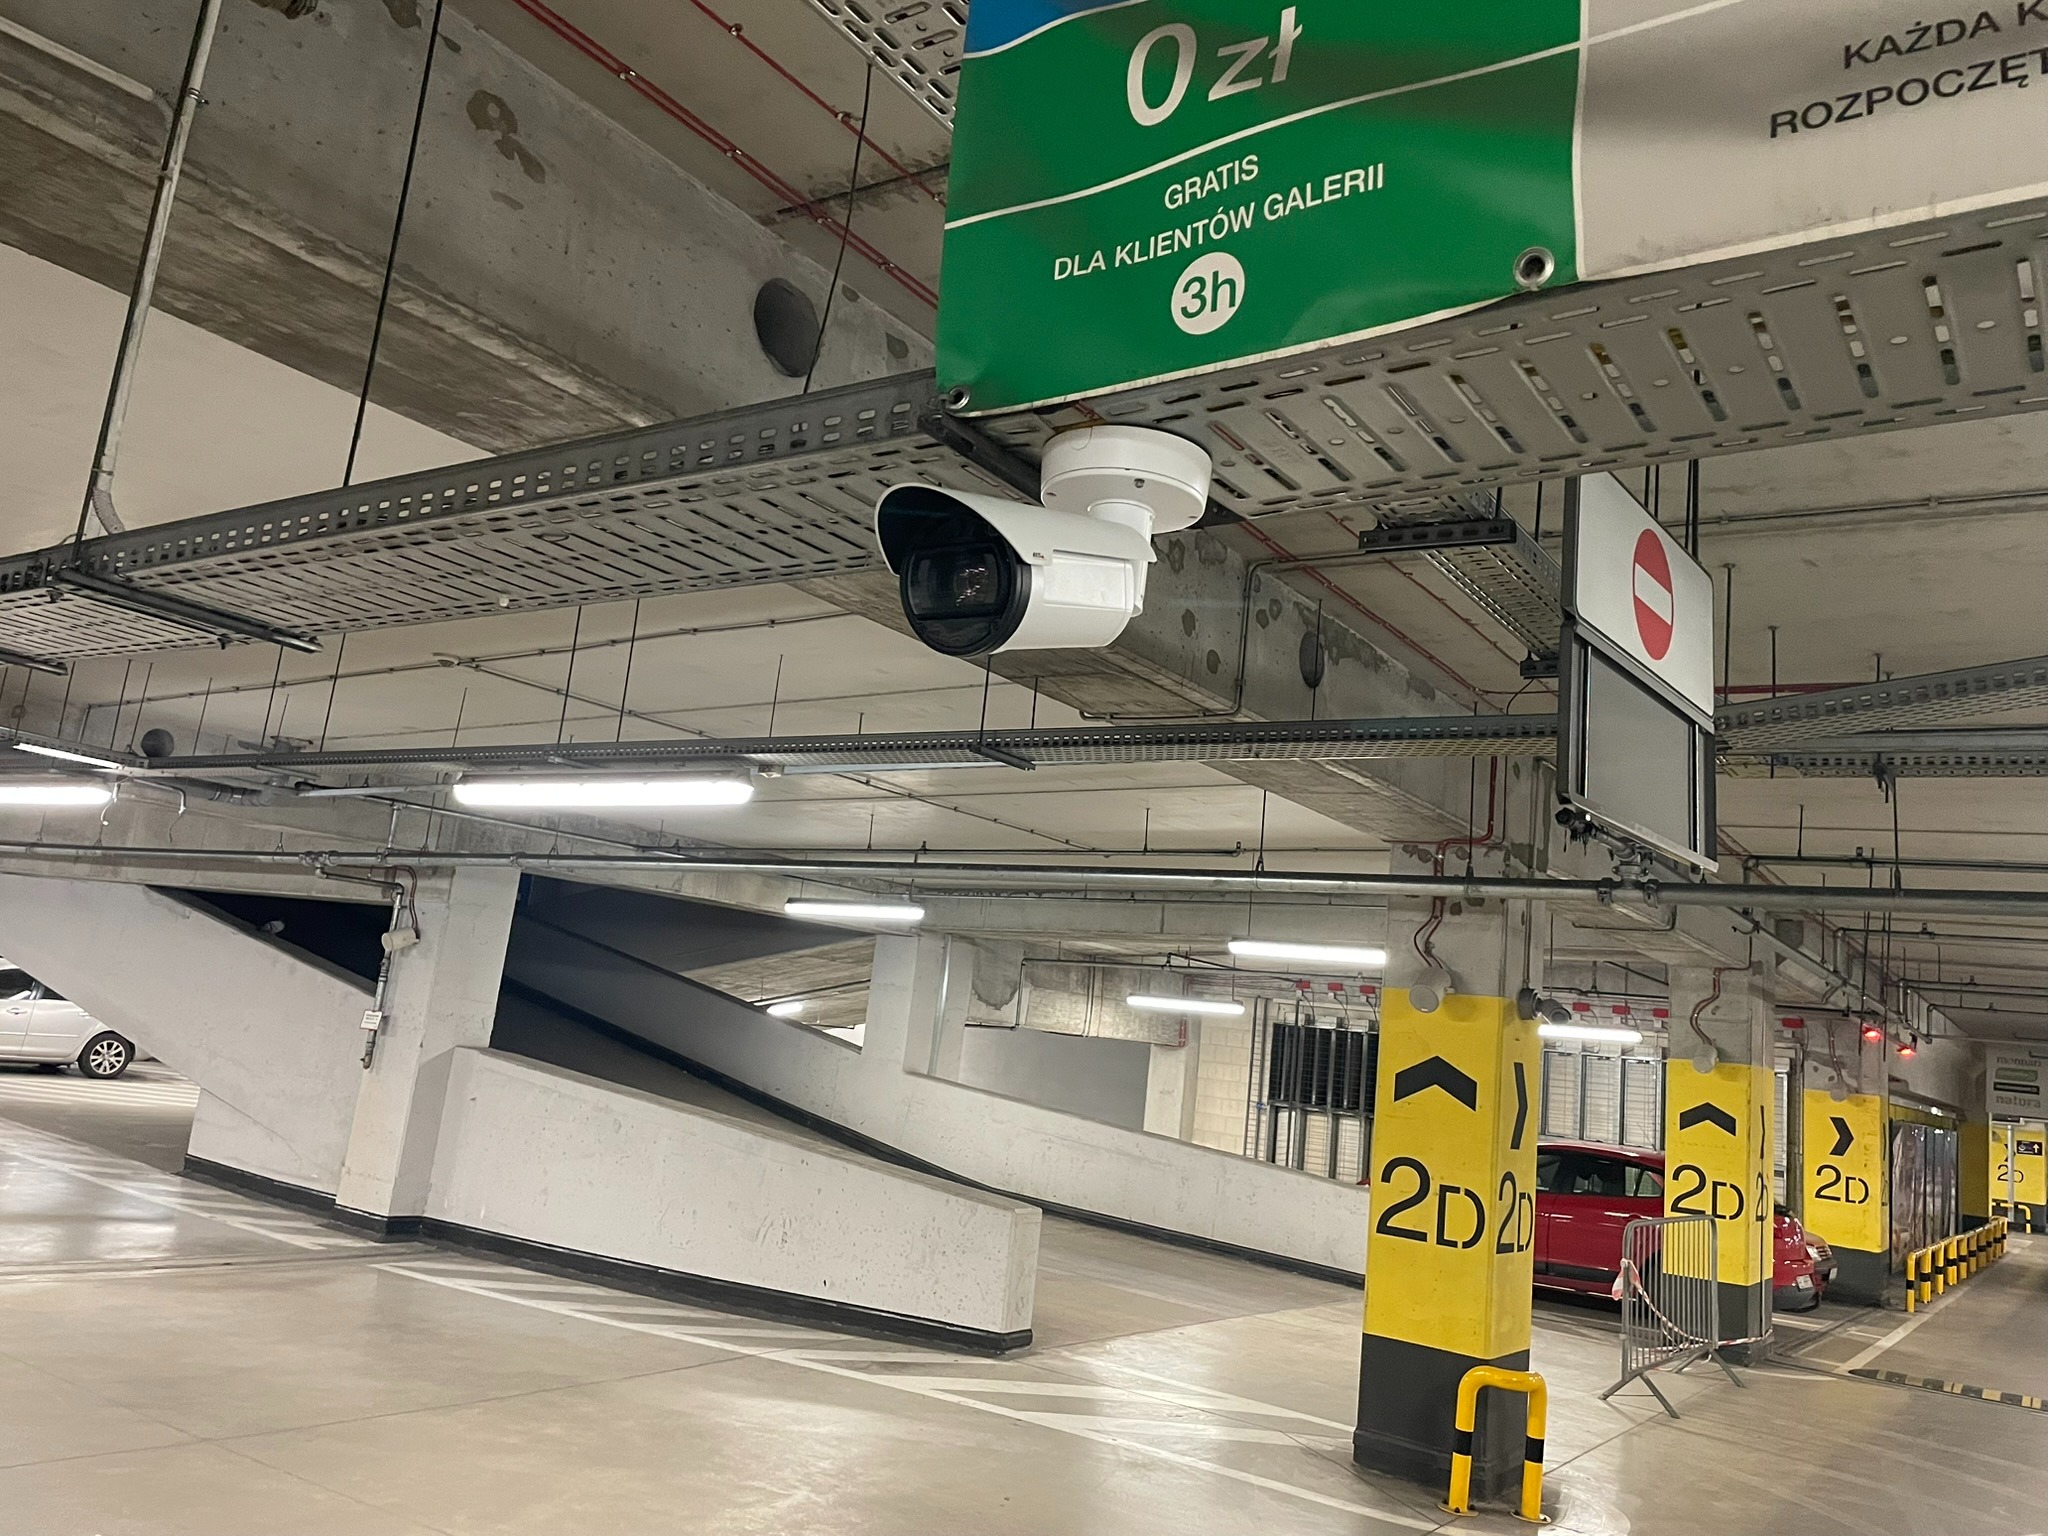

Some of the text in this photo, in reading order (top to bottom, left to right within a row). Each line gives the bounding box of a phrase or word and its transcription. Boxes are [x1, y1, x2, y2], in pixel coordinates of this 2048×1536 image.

[1127, 6, 1302, 126] 0 zł
[1844, 11, 2001, 69] KAŻDA
[1164, 154, 1259, 209] GRATIS
[1054, 163, 1384, 281] DLA KLIENTÓW GALERII
[1181, 270, 1237, 319] 3h
[1376, 1156, 1486, 1249] 2D
[1495, 1171, 1534, 1255] 2D
[1670, 1164, 1745, 1220] 2D
[1814, 1164, 1870, 1205] 2D
